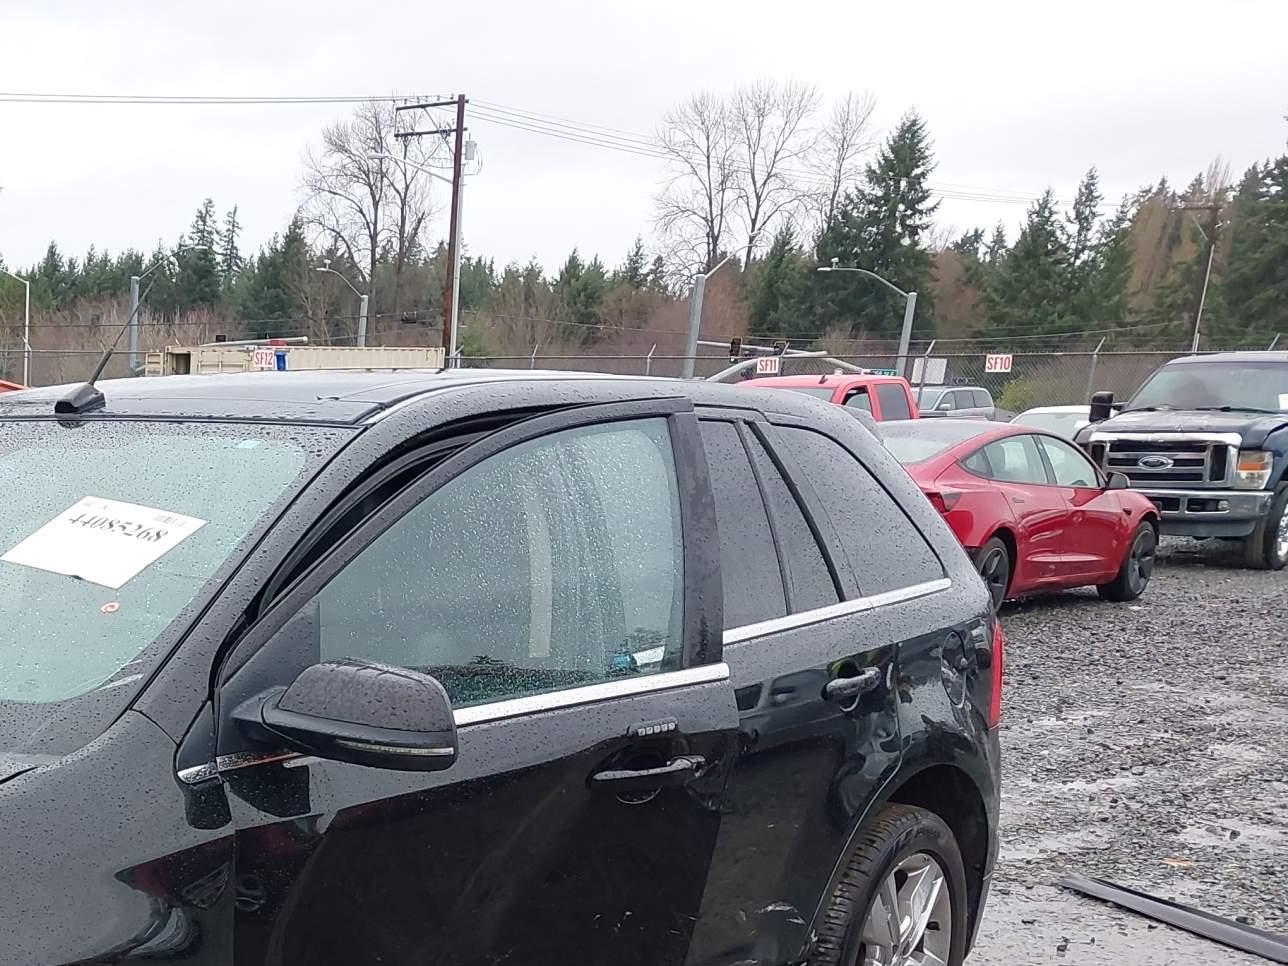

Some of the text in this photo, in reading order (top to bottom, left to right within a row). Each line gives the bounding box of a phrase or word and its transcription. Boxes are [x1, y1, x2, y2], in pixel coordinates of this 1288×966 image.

[255, 351, 273, 366] SF12
[759, 359, 777, 371] SF11
[987, 356, 1011, 370] SF10
[69, 513, 169, 542] 44085268
